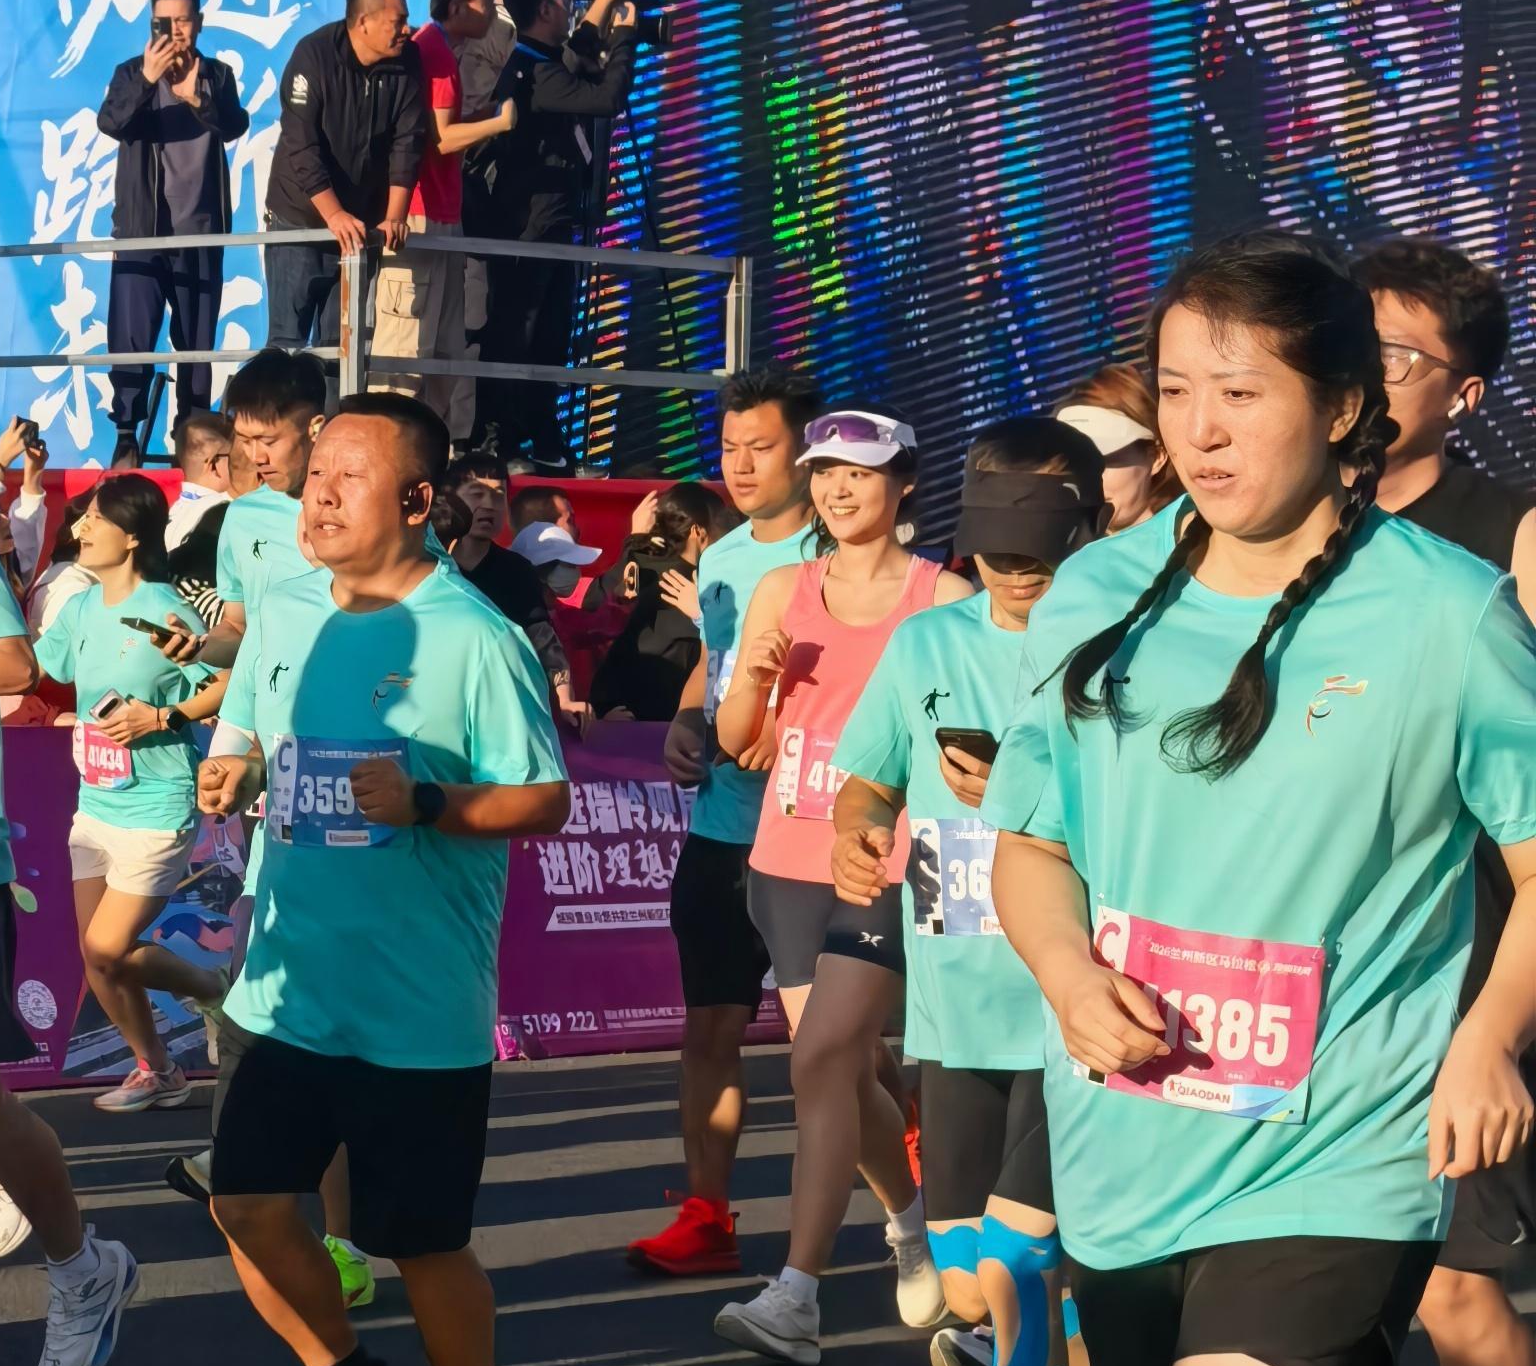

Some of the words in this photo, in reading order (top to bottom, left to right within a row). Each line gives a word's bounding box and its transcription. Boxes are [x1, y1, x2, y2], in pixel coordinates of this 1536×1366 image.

[88, 745, 125, 771] 41434
[278, 741, 292, 773] C
[298, 775, 365, 815] 359
[567, 1011, 599, 1031] 222
[1143, 982, 1292, 1067] 1385
[1177, 1086, 1231, 1105] QIAODAN
